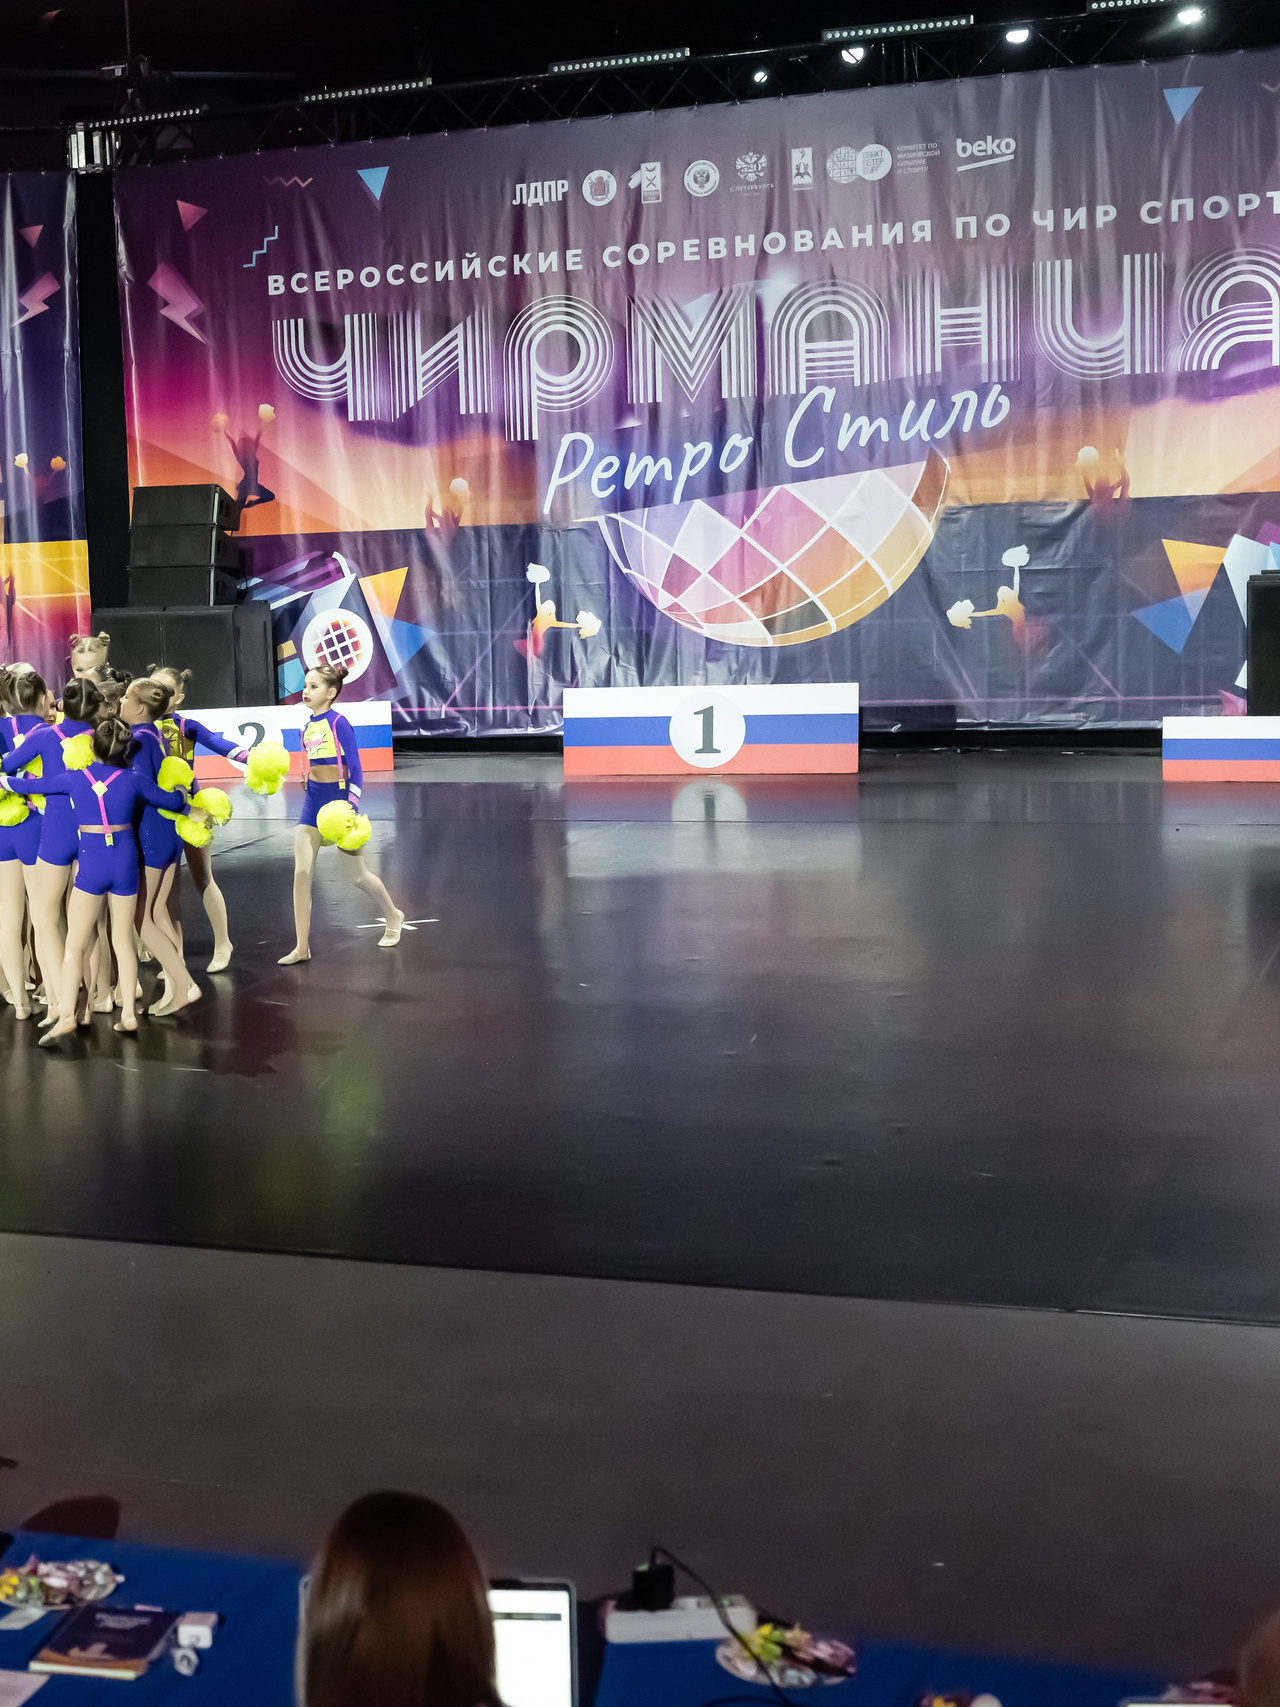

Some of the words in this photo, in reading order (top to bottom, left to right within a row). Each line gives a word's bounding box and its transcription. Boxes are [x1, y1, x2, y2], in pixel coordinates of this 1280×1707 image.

[956, 135, 1017, 158] beko
[512, 180, 569, 207] ЛДПР
[268, 248, 583, 295] ВСЕРОССИЙСКИЕ
[602, 219, 933, 268] СОРЕВНОВАНИЯ
[956, 213, 1010, 239] ПО
[1033, 205, 1118, 232] ЧИР
[543, 431, 754, 515] Ретро
[784, 383, 1012, 468] Стиль
[693, 705, 721, 754] 1
